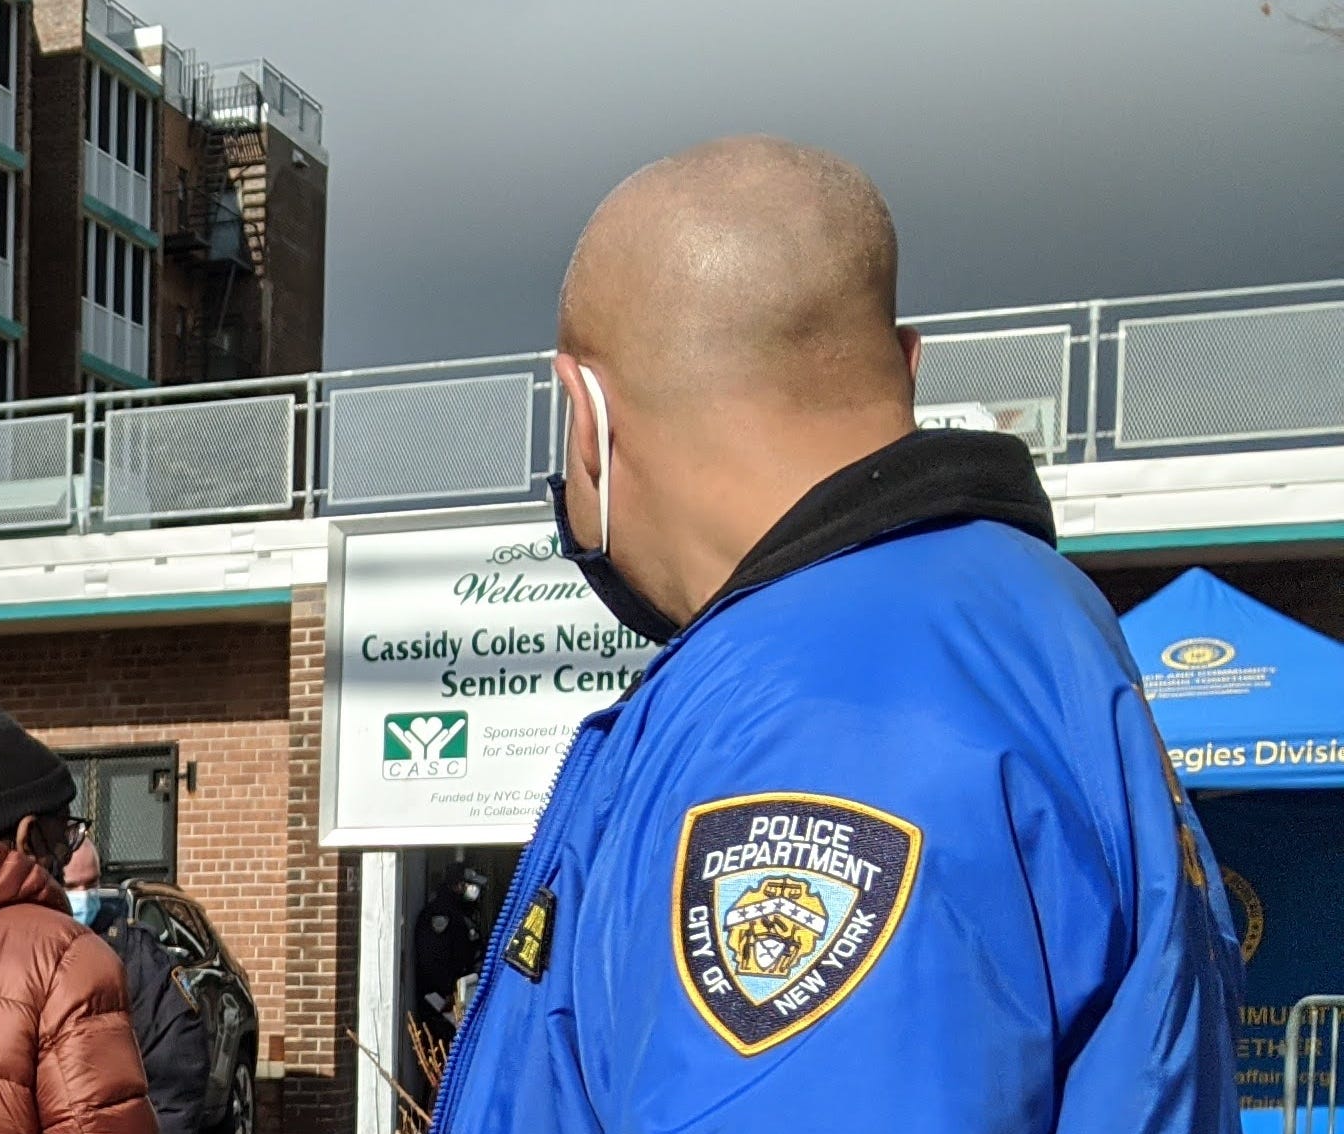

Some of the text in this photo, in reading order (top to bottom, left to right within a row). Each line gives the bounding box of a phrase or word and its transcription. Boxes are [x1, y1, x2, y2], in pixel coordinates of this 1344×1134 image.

[454, 572, 592, 606] Welcome
[362, 622, 664, 666] Cassidy Coles Neighb
[441, 669, 542, 697] Senior
[483, 724, 557, 741] Sponsored
[482, 745, 501, 757] for
[505, 743, 550, 756] Senior
[389, 761, 459, 777] CASC
[430, 793, 472, 803] Funded
[476, 791, 490, 803] by
[493, 790, 521, 801] NYC
[748, 815, 855, 851] POLICE
[701, 841, 883, 892] DEPARTMENT
[687, 905, 734, 996] CITY OF
[773, 908, 877, 1016] NEW YORK
